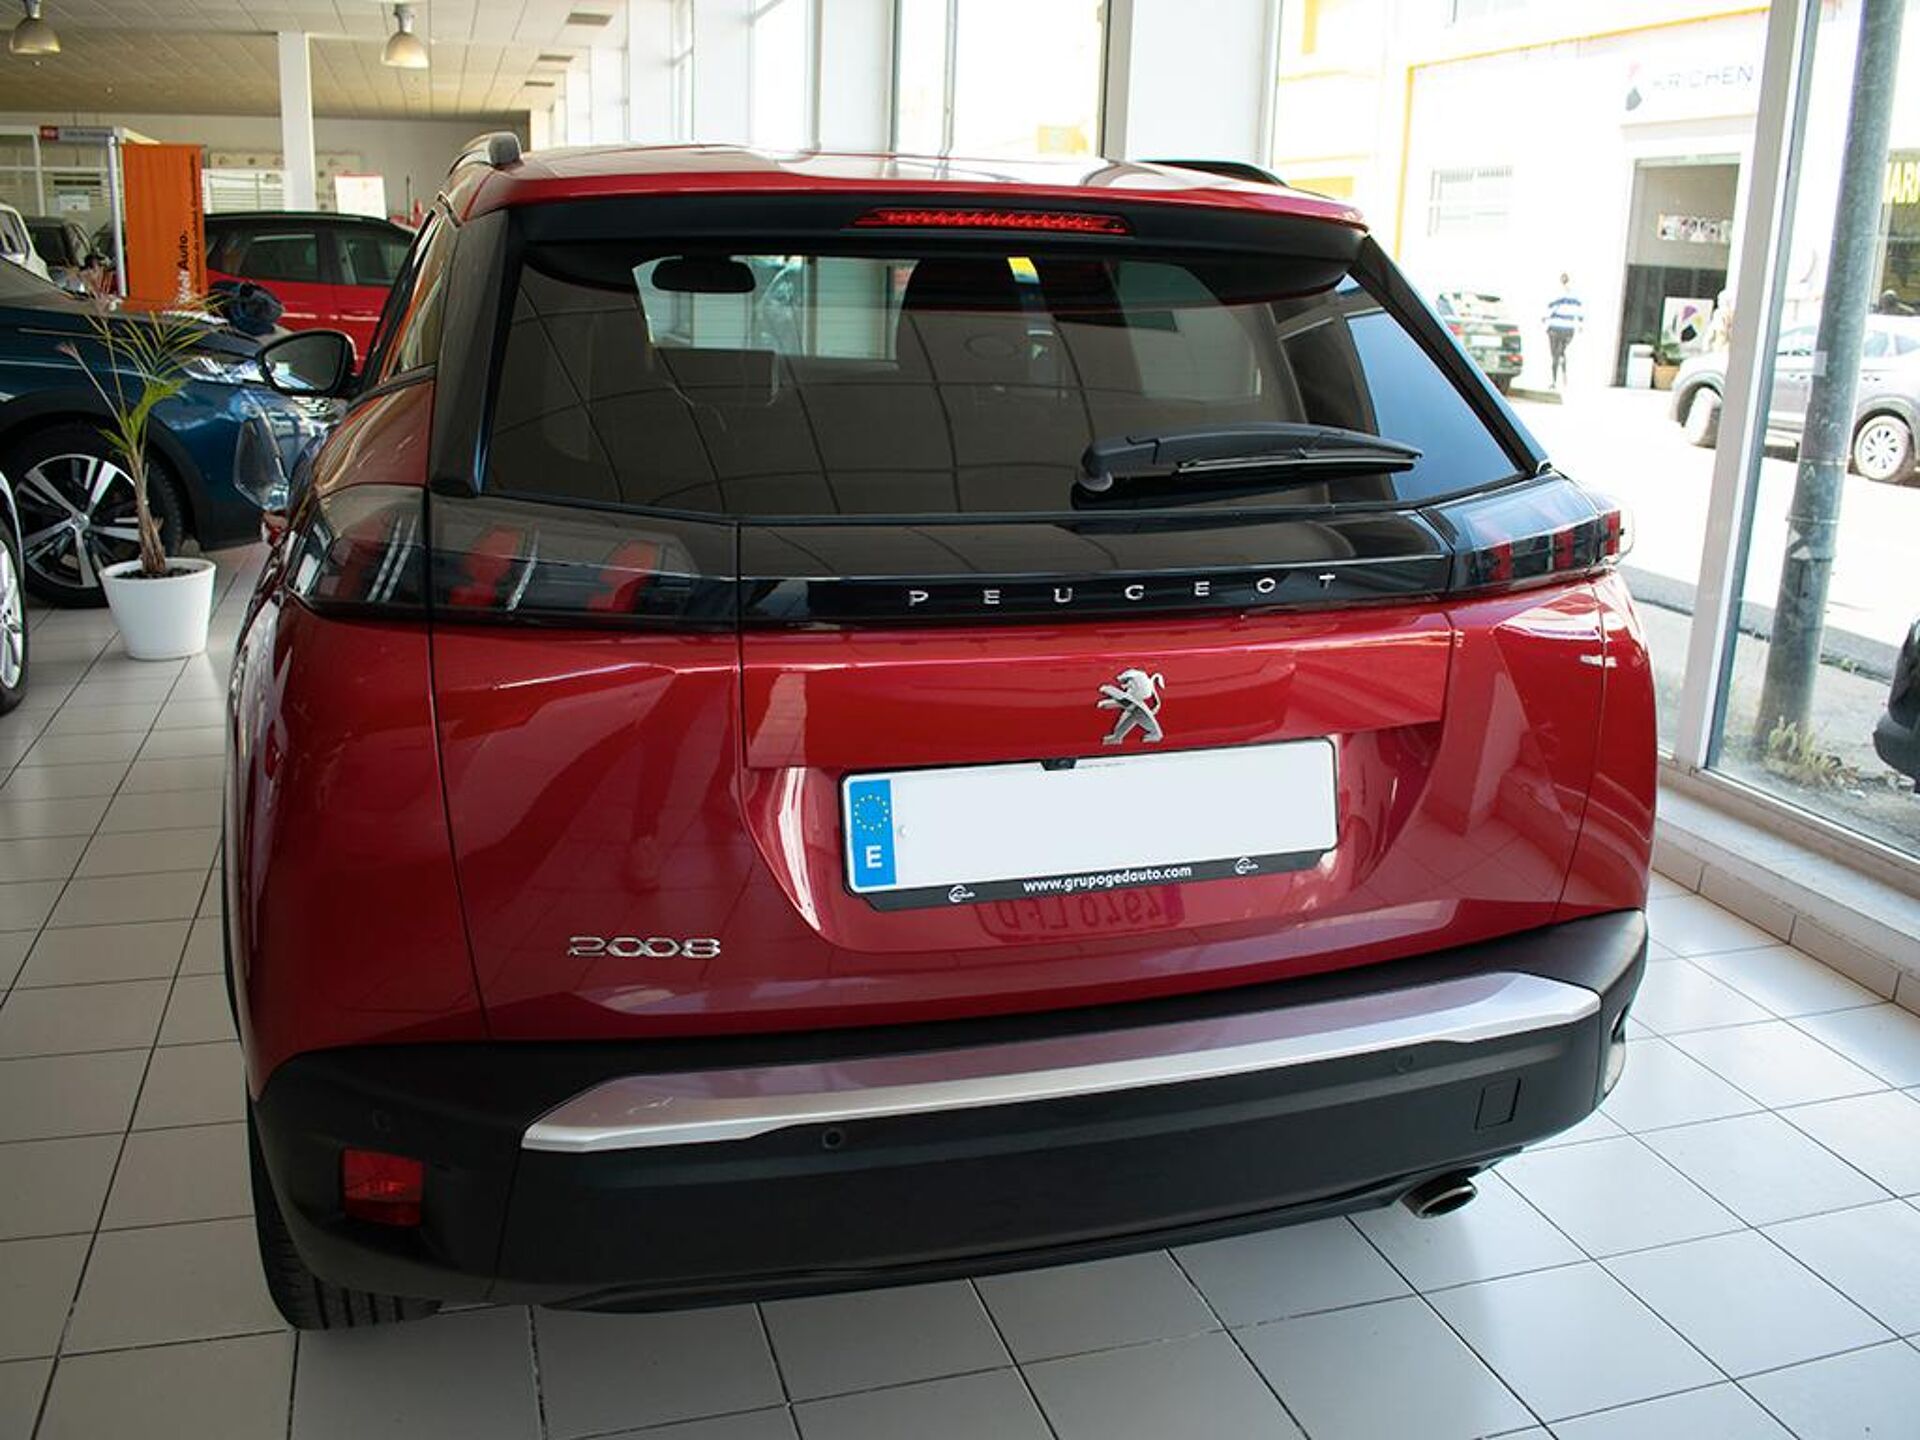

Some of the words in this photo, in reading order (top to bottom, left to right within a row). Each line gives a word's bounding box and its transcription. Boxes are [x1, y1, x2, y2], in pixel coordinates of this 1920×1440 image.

[908, 572, 1337, 607] PEUGEOT
[865, 845, 883, 869] E
[1022, 866, 1192, 893] www.grupogedauto.com
[567, 936, 721, 959] 2008
